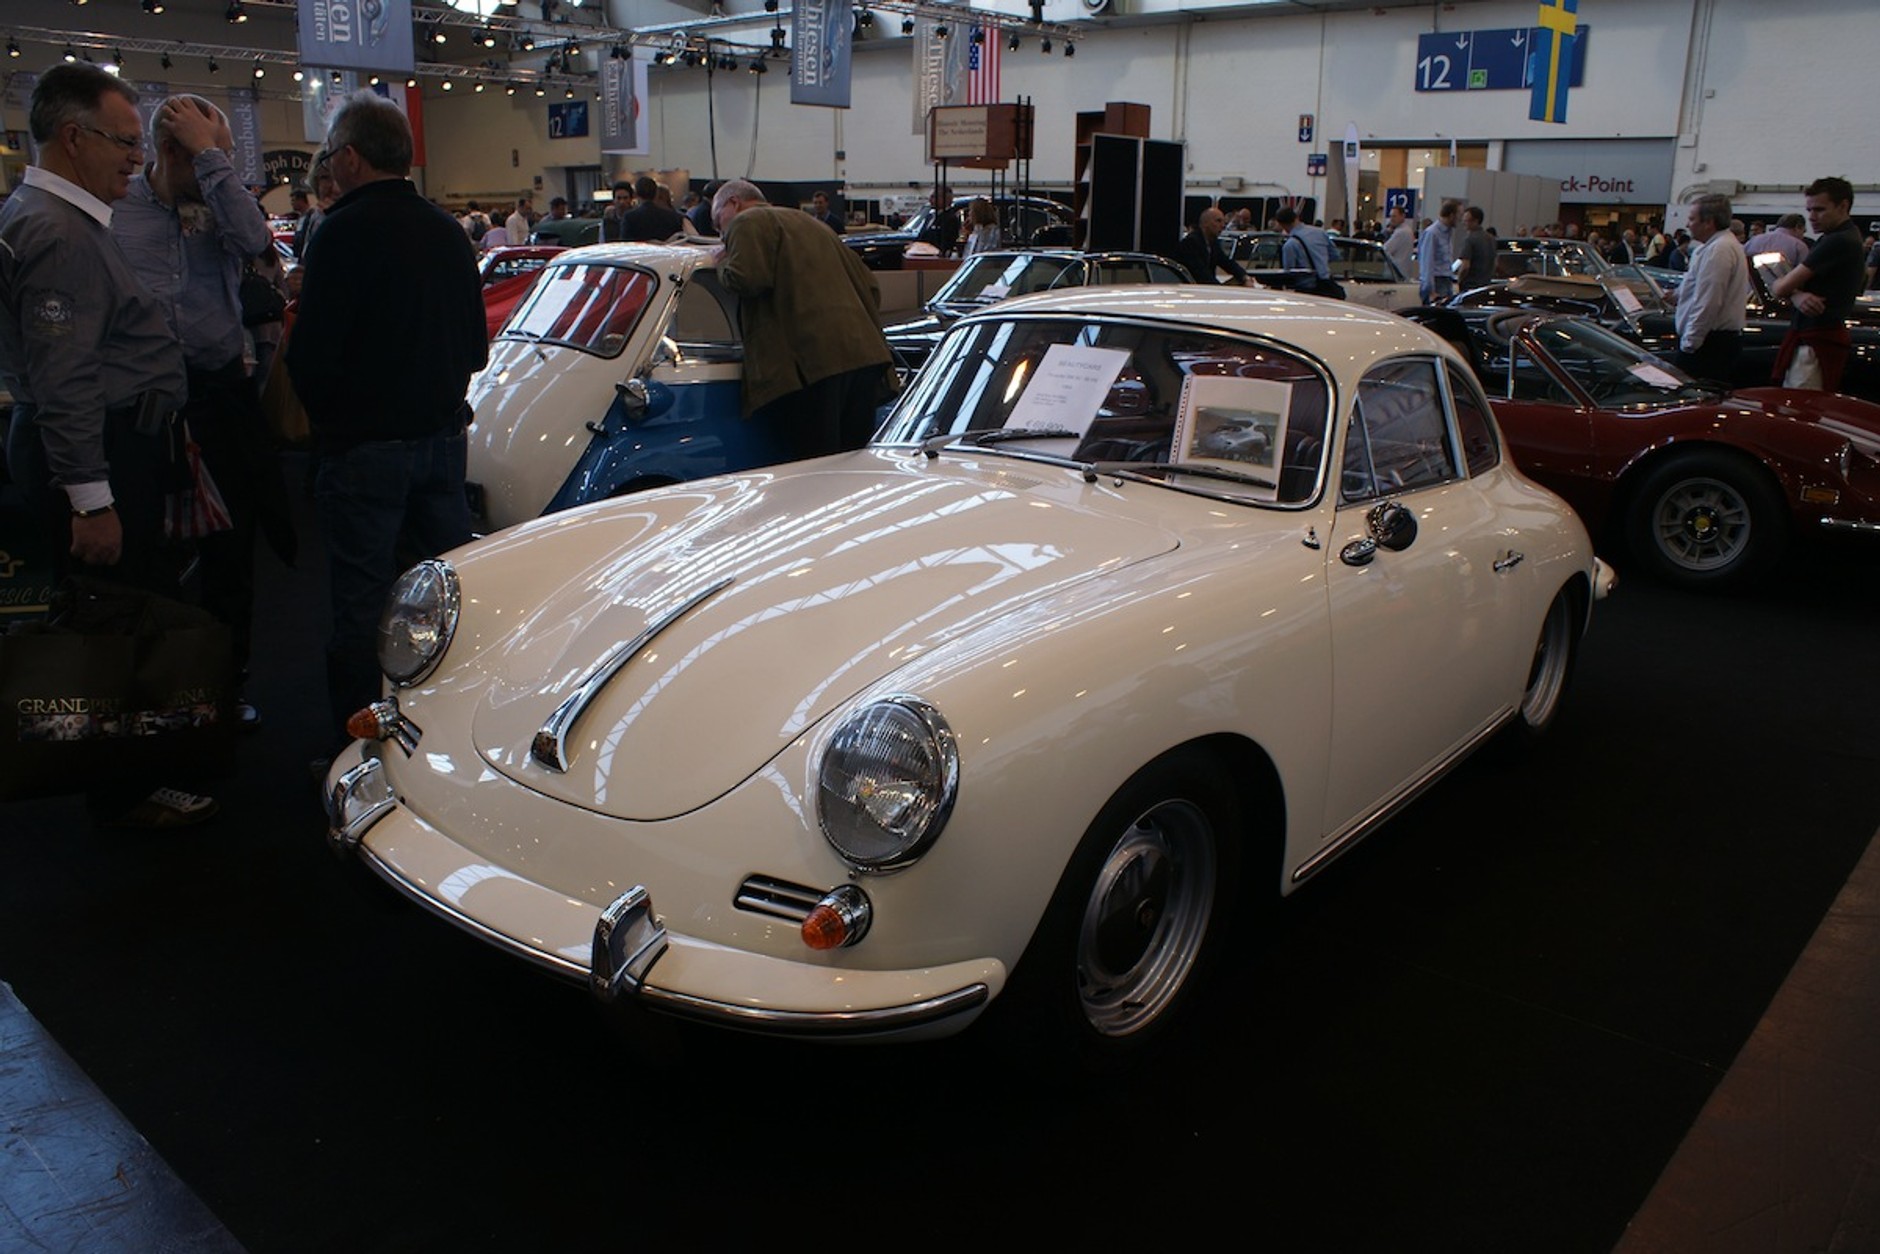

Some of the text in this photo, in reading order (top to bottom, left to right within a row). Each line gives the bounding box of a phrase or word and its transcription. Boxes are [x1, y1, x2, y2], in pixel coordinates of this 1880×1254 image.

[1418, 54, 1452, 90] 12
[549, 115, 564, 138] 12
[236, 103, 257, 182] Steenbuck
[1560, 175, 1635, 193] ck-Point
